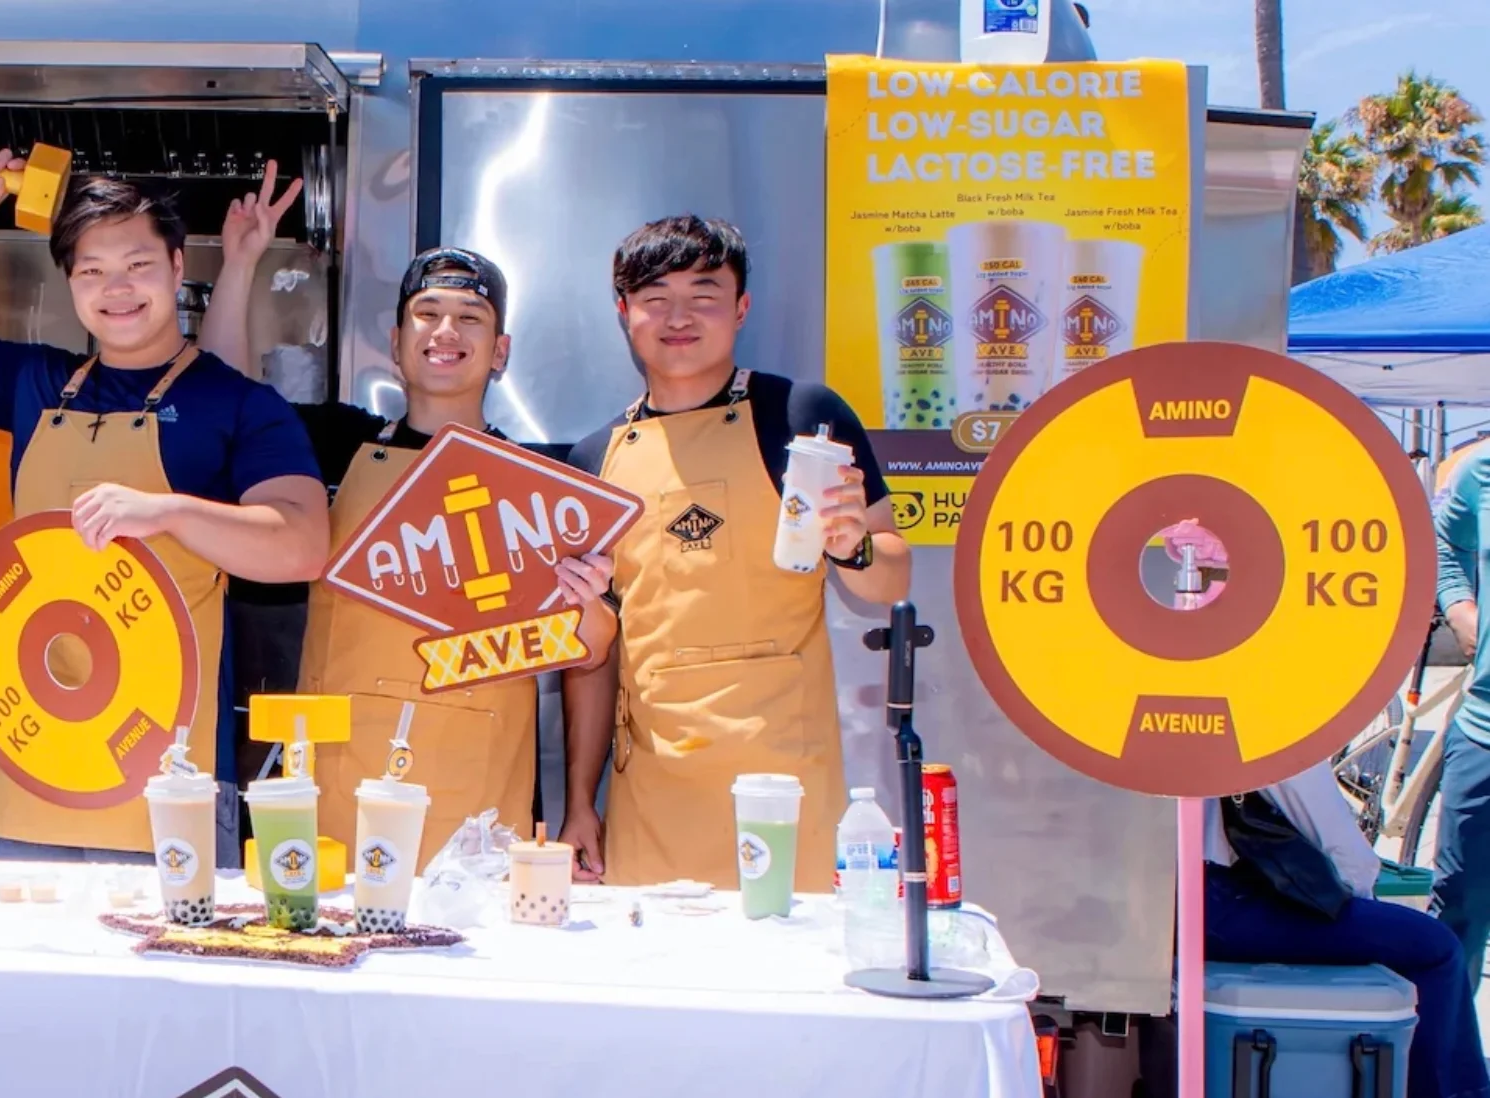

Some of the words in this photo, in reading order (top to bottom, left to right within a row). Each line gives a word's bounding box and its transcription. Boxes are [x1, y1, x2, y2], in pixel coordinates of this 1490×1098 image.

[867, 70, 1143, 99] LOW-CALORIE
[868, 110, 1105, 140] LOW-SUGAR
[867, 150, 1156, 183] LACTOSE-FREE
[957, 193, 983, 203] Black
[986, 193, 1012, 202] Fresh
[1015, 192, 1034, 201] Milk
[1038, 193, 1055, 201] Tea
[987, 207, 1024, 217] w/boba
[1064, 208, 1104, 217] Jasmine
[1106, 207, 1134, 216] Fresh
[1137, 207, 1156, 216] Milk
[1159, 206, 1178, 216] Tea
[850, 211, 889, 220] Jasmine
[892, 210, 927, 219] Matcha
[930, 209, 955, 218] Latte
[884, 223, 921, 233] w/boba
[1103, 222, 1141, 231] w/boba
[910, 349, 934, 357] AVE
[988, 345, 1016, 355] AVE
[1074, 347, 1099, 355] AVE
[1148, 400, 1231, 421] AMINO
[367, 473, 590, 612] AMINO
[996, 520, 1074, 553] 100
[1301, 519, 1388, 554] 100
[93, 558, 134, 602] 100
[1000, 569, 1065, 604] KG
[1305, 571, 1379, 608] KG
[115, 587, 153, 630] KG
[459, 625, 544, 674] AVE
[6, 713, 41, 753] KG
[114, 716, 152, 761] AVENUE
[1139, 712, 1226, 736] AVENUE
